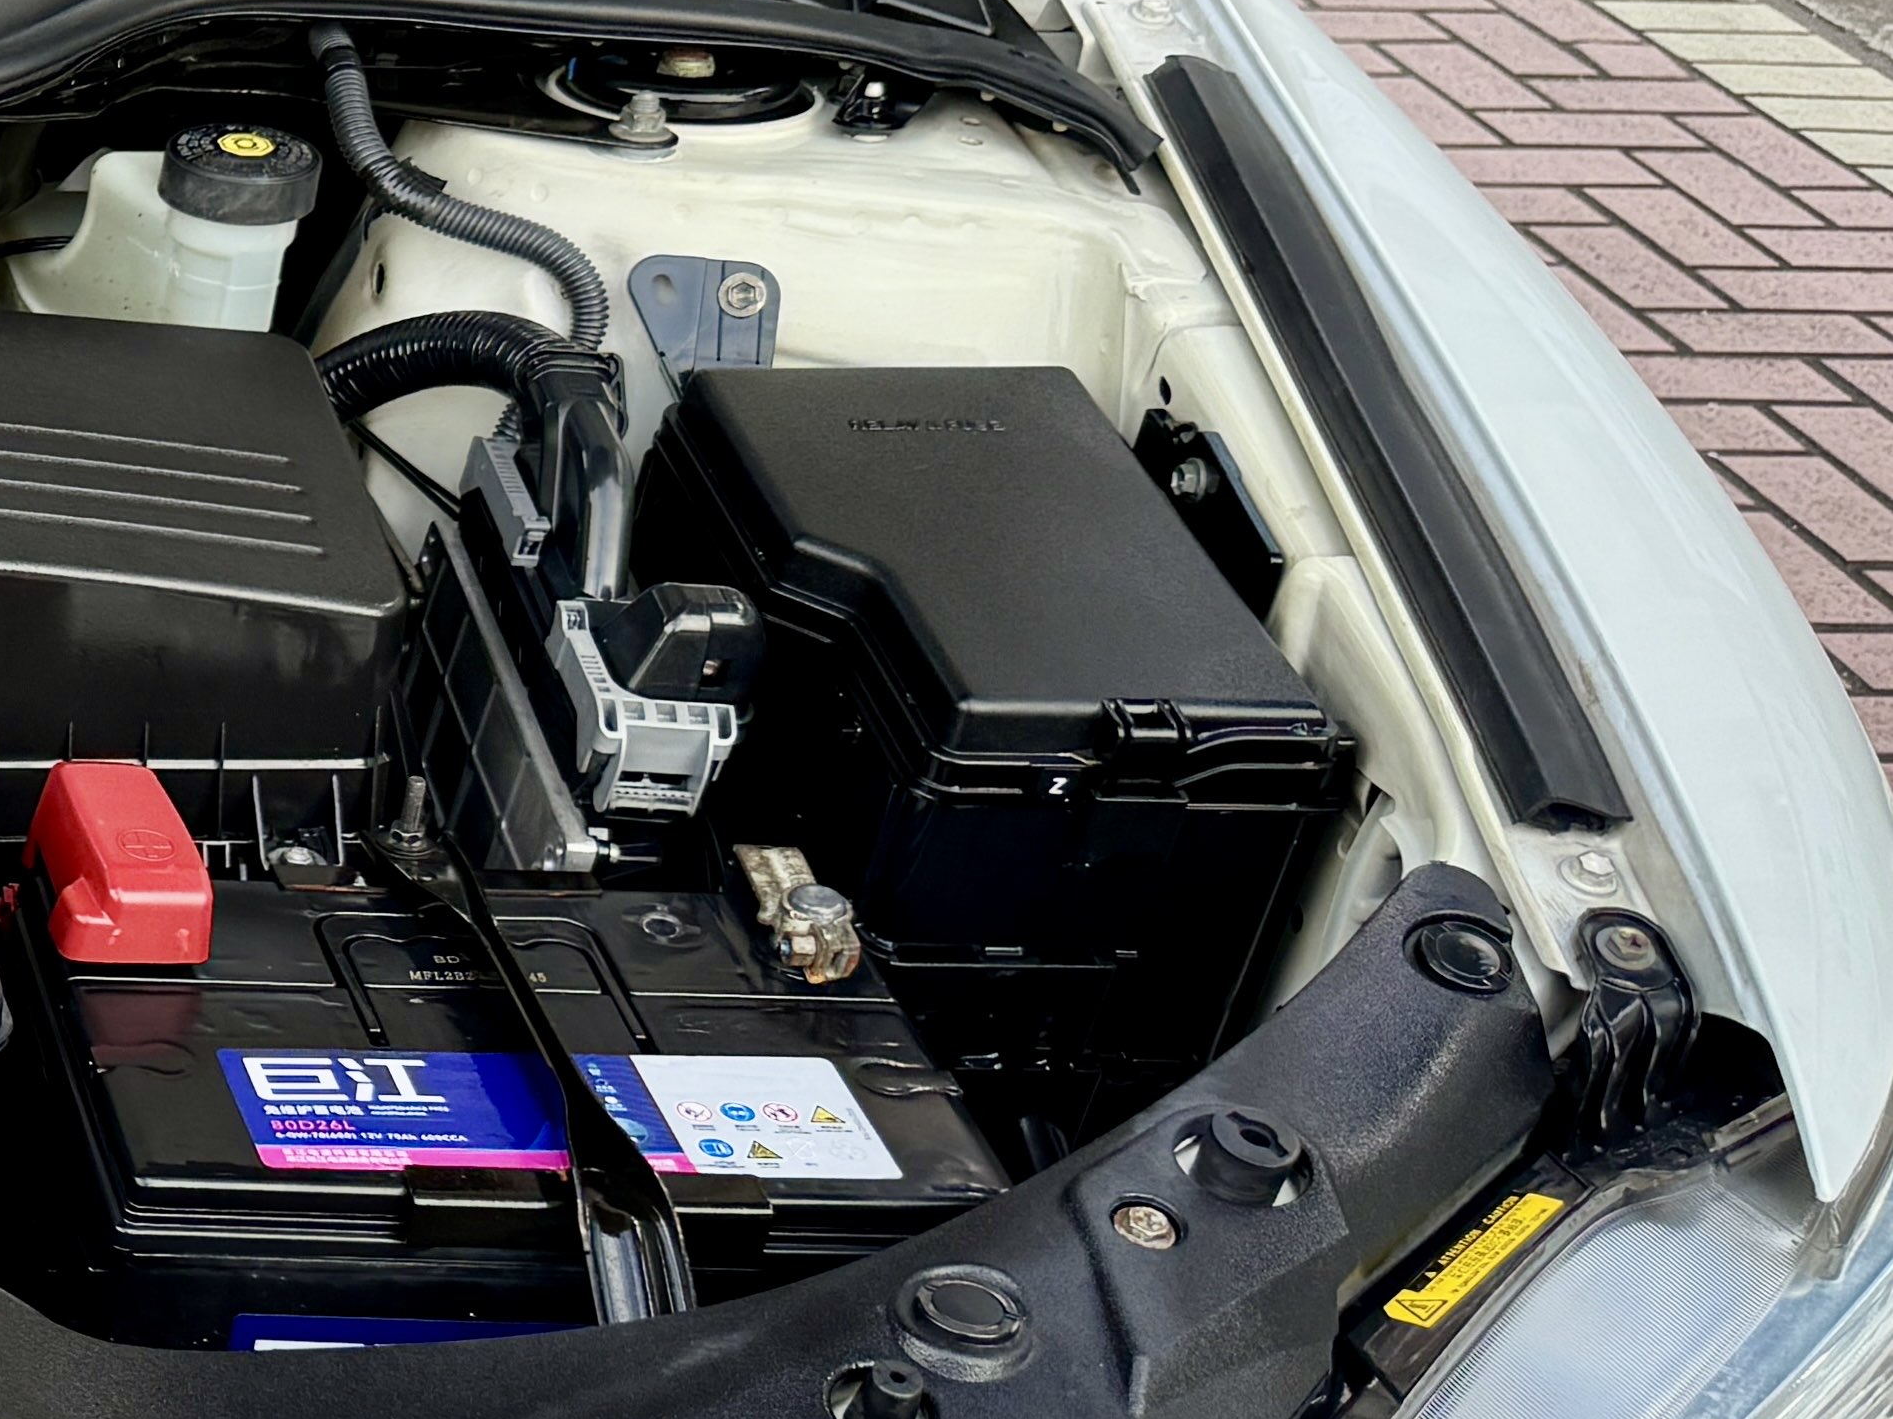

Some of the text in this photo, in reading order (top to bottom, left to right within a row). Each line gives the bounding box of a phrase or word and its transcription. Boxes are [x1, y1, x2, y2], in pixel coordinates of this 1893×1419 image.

[1048, 777, 1067, 794] Z
[242, 1057, 446, 1102] 巨江
[270, 1119, 356, 1131] 80D26L
